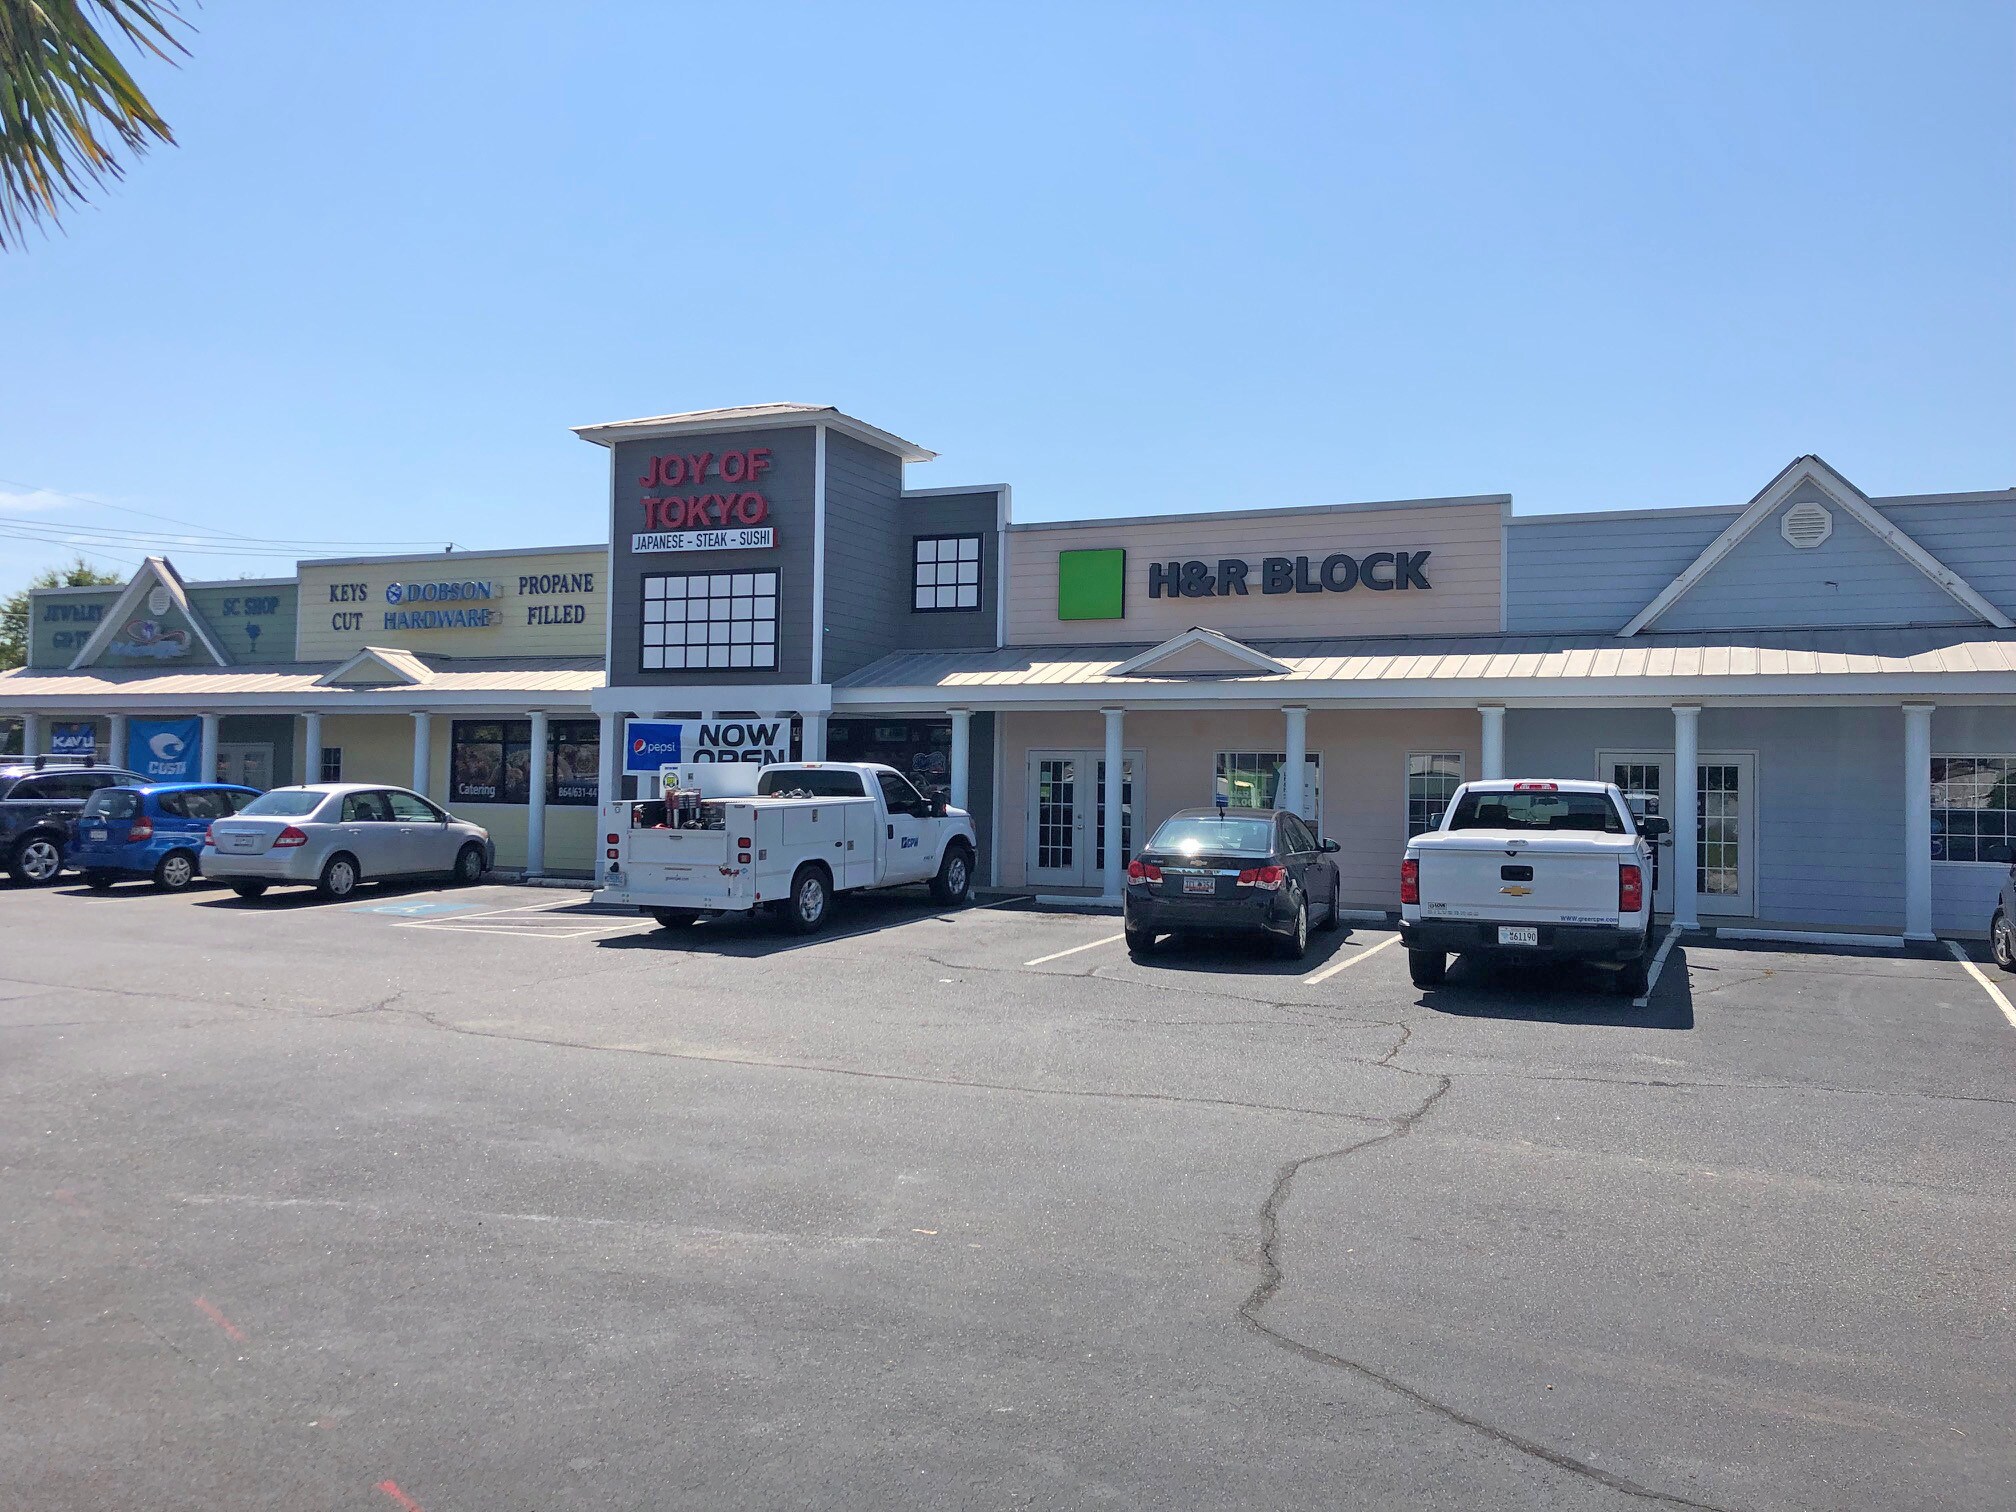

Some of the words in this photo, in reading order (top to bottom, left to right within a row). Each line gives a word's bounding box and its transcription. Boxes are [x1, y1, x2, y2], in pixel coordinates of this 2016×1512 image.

[638, 452, 714, 488] JOY
[719, 448, 771, 483] OF
[639, 491, 768, 530] TOKYO
[635, 534, 684, 551] JAPANESE
[696, 532, 727, 548] STEAK
[740, 530, 770, 546] SUSHI
[518, 573, 594, 595] PROPANE
[1148, 558, 1249, 598] H&R
[1262, 550, 1432, 595] BLOCK
[329, 584, 367, 602] KEYS
[407, 581, 492, 602] DOBSON
[332, 613, 363, 631] CUT
[384, 608, 491, 630] HARDWARE
[527, 605, 585, 625] FILLED
[53, 736, 95, 748] KAVU
[699, 723, 781, 747] NOW
[647, 742, 676, 754] pepsi
[459, 783, 496, 799] Catering
